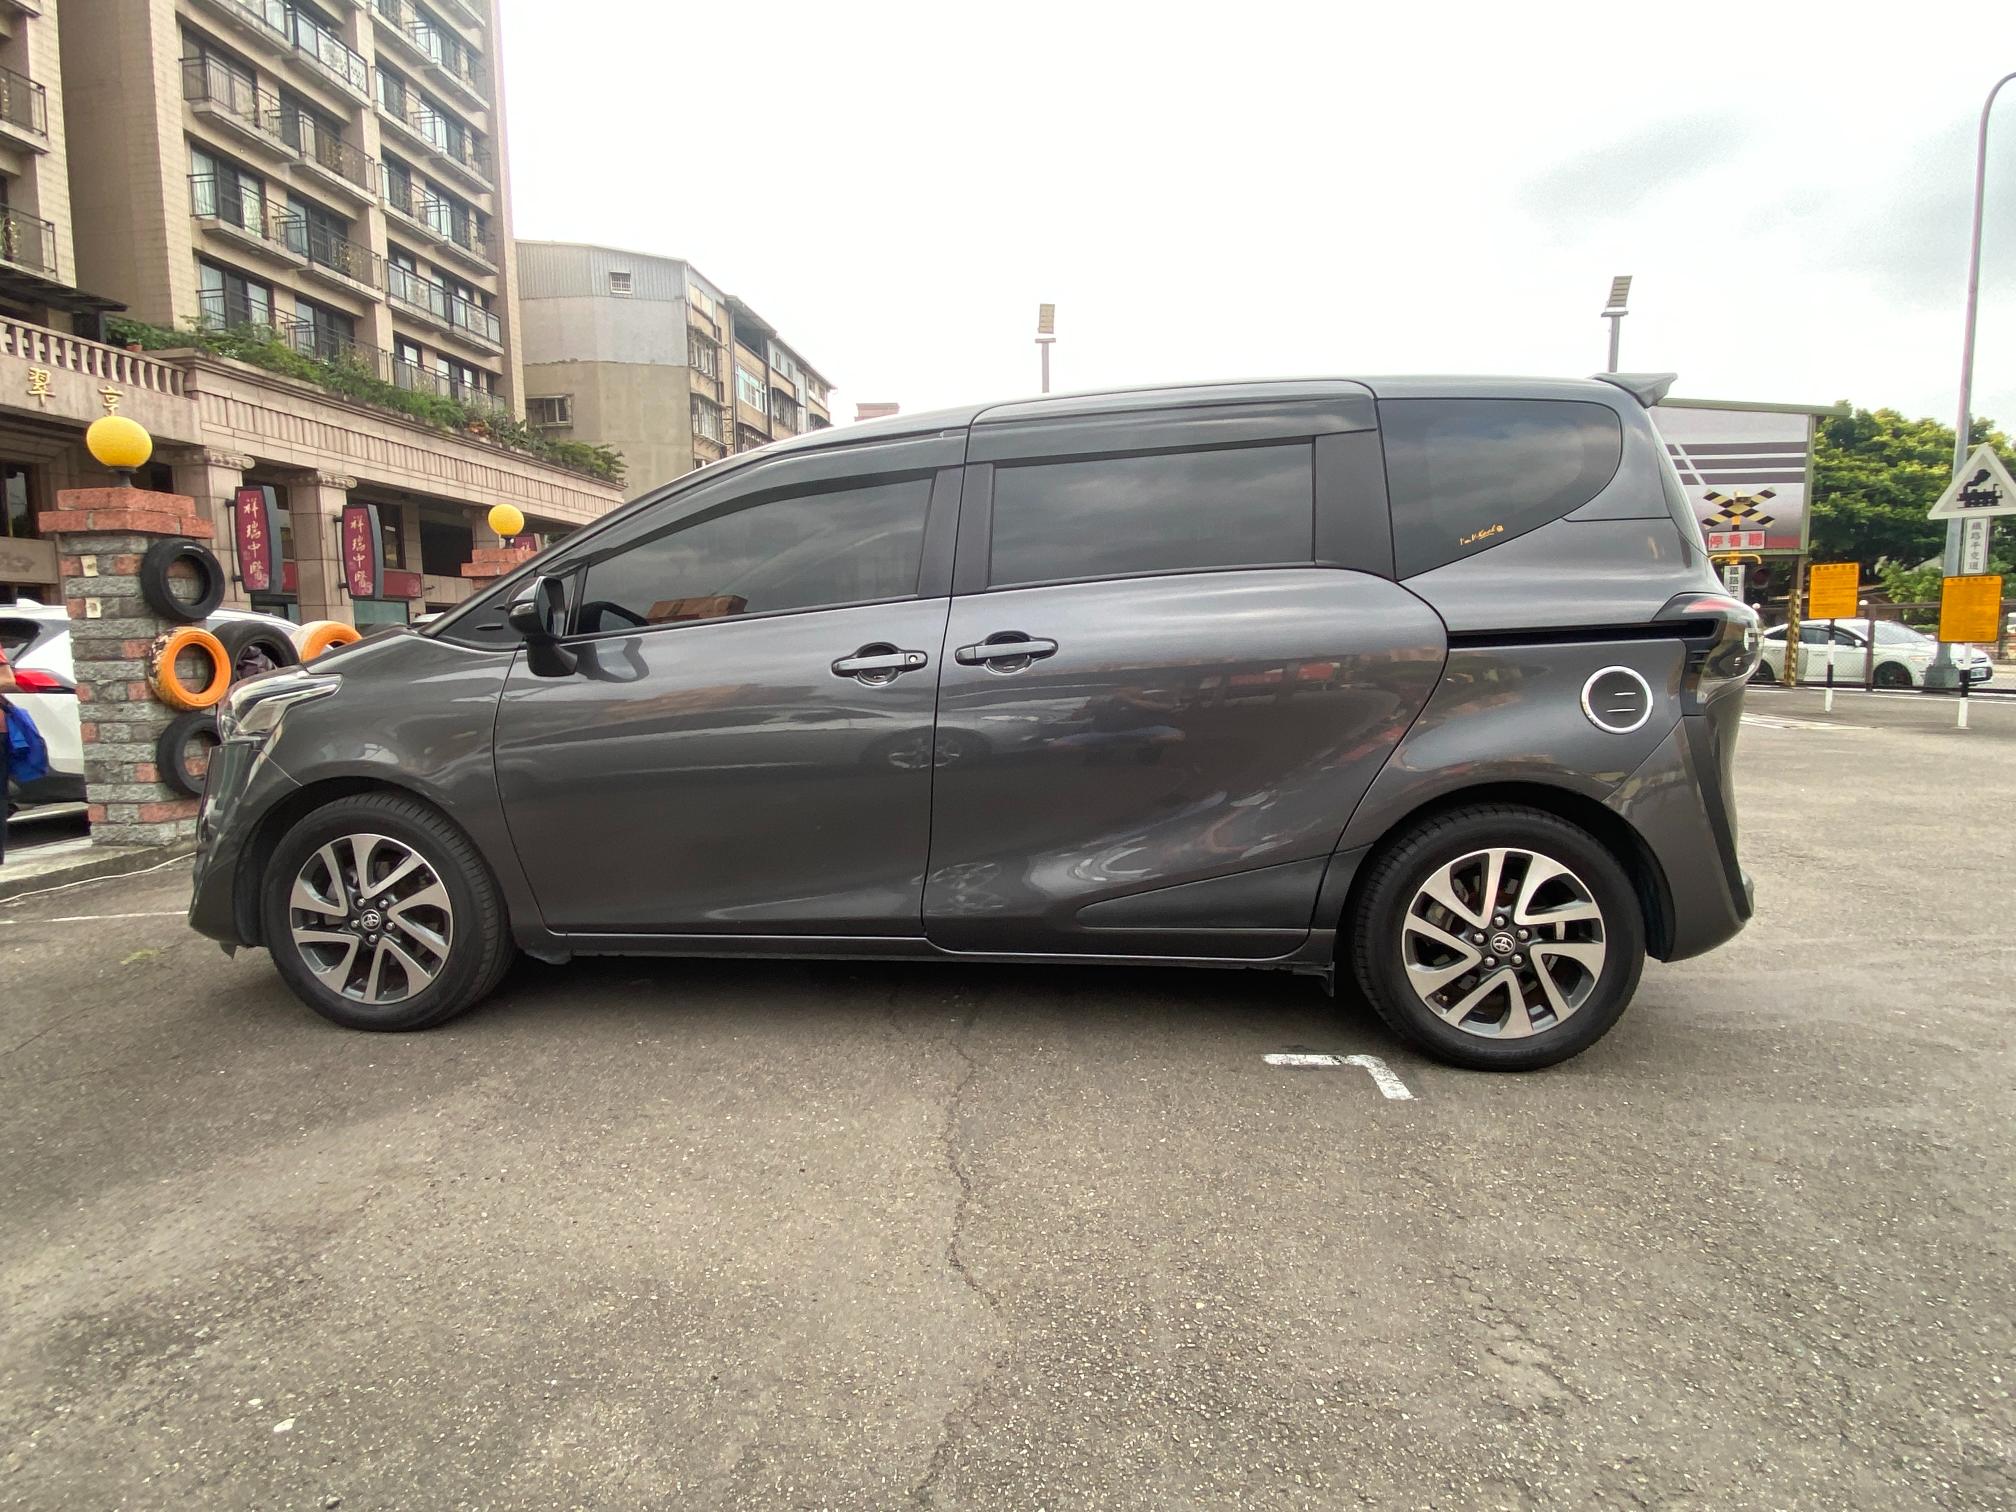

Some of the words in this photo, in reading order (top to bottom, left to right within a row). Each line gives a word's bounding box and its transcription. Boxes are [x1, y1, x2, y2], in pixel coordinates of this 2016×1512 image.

[243, 497, 265, 582] 祥瑞中醫
[350, 515, 369, 588] 祥瑞中醫
